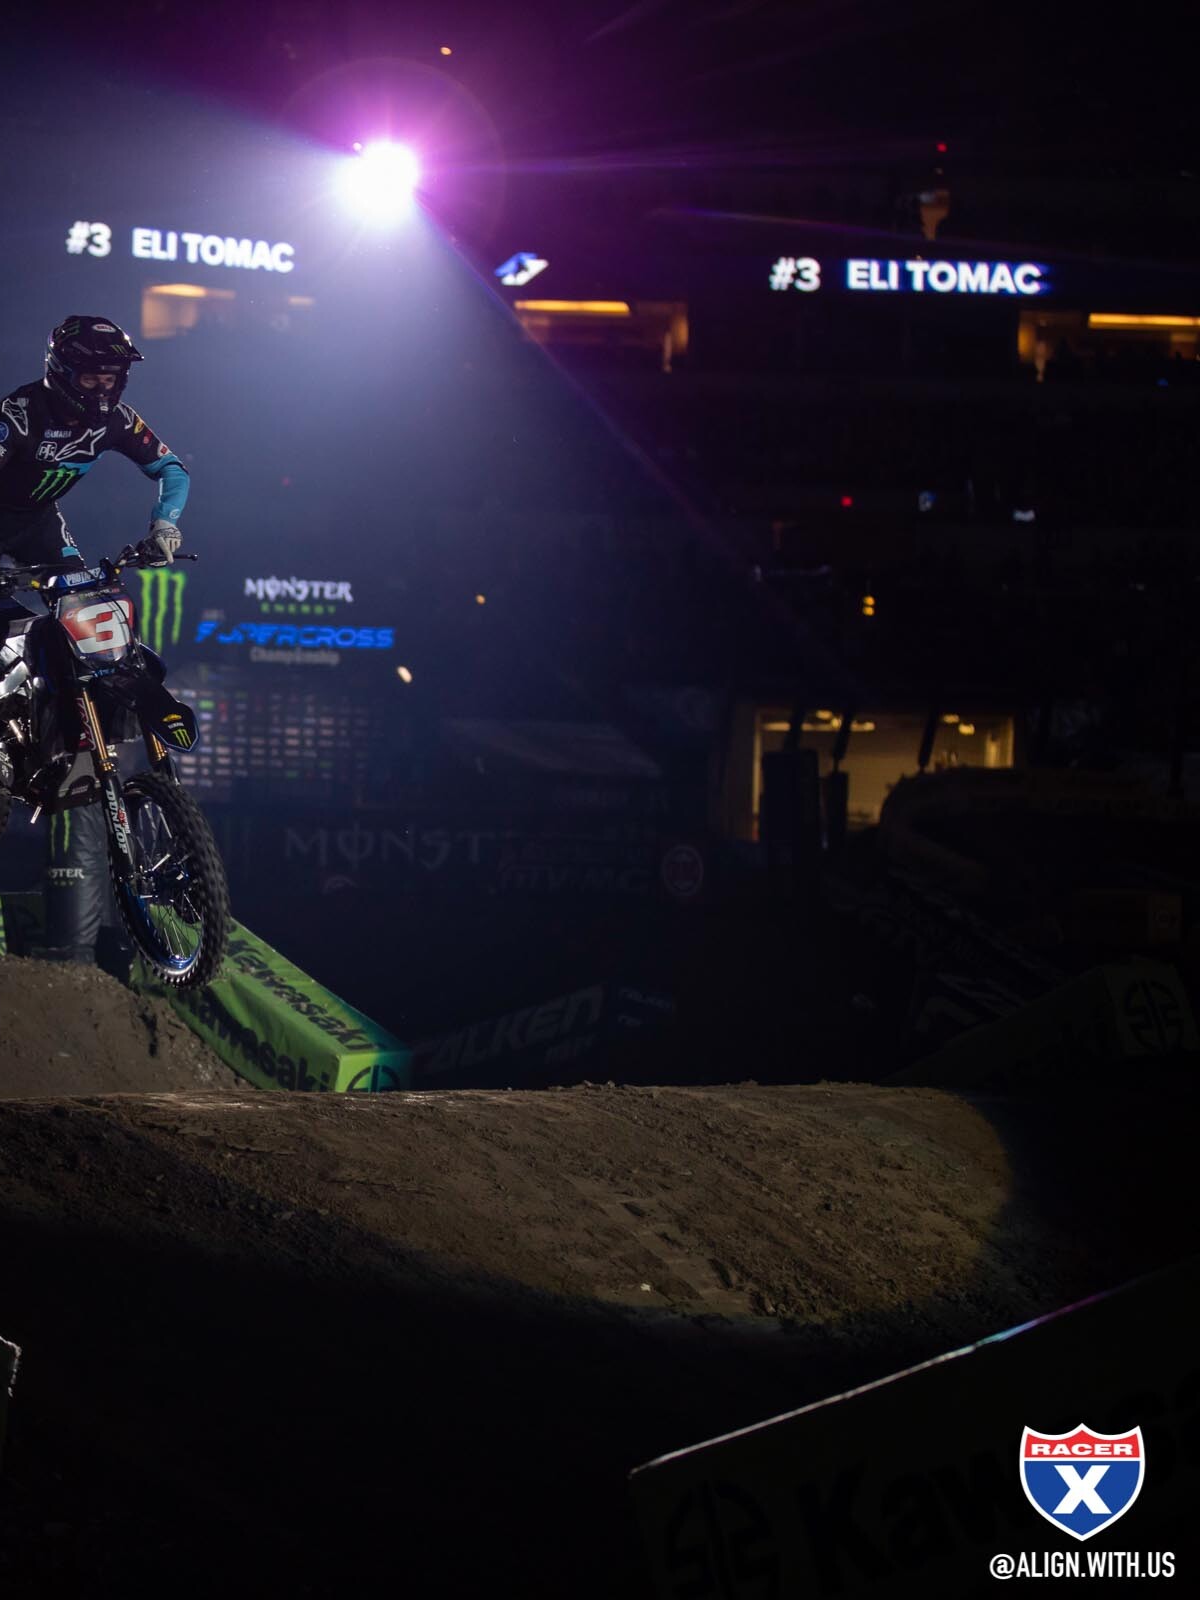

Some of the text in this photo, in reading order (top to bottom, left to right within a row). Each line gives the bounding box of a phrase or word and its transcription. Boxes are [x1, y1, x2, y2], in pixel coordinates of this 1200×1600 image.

[66, 221, 295, 273] #3 ELI TOMAC
[769, 256, 1043, 295] #3 ELI TOMAC
[244, 577, 353, 602] MONSTER
[77, 600, 130, 653] 3
